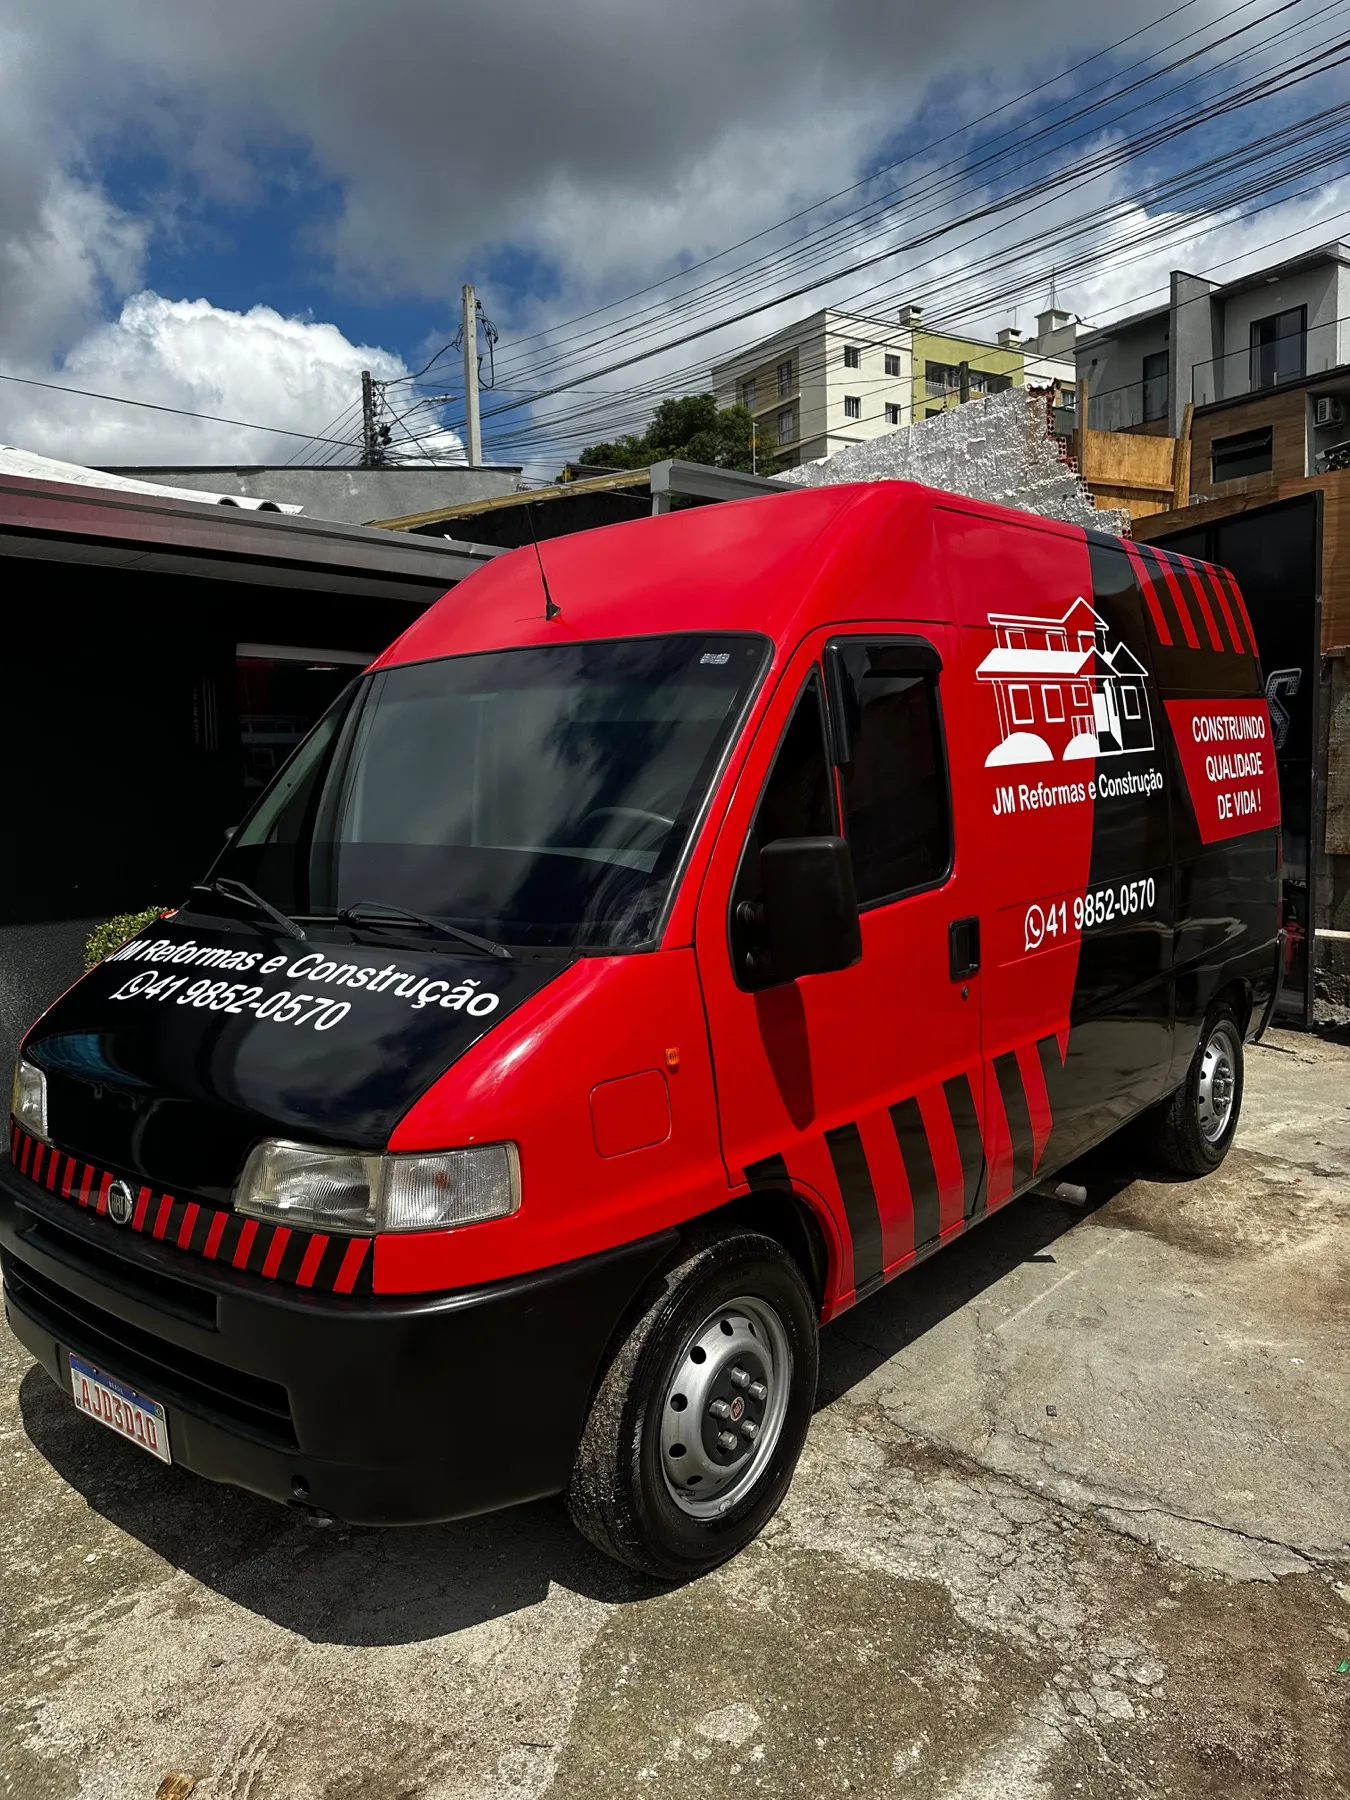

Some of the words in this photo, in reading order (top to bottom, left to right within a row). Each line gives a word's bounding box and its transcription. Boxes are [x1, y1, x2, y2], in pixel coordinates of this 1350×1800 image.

[1192, 715, 1266, 743] CONSTRUINDO
[992, 786, 1016, 816] JM
[1018, 781, 1086, 812] Reformas
[1088, 781, 1097, 800] e
[1098, 767, 1164, 798] Construção
[1205, 751, 1264, 783] QUALIDADE
[1217, 793, 1233, 820] DE
[1046, 900, 1067, 938] 41
[1073, 877, 1155, 930] 9852-0570
[104, 939, 152, 963] JM
[133, 939, 264, 971] Reformas
[259, 955, 288, 974] e
[286, 952, 500, 1017] Construção
[143, 974, 190, 1002] 41
[176, 979, 352, 1031] 9852-0570
[82, 1377, 159, 1450] AJD3D10
